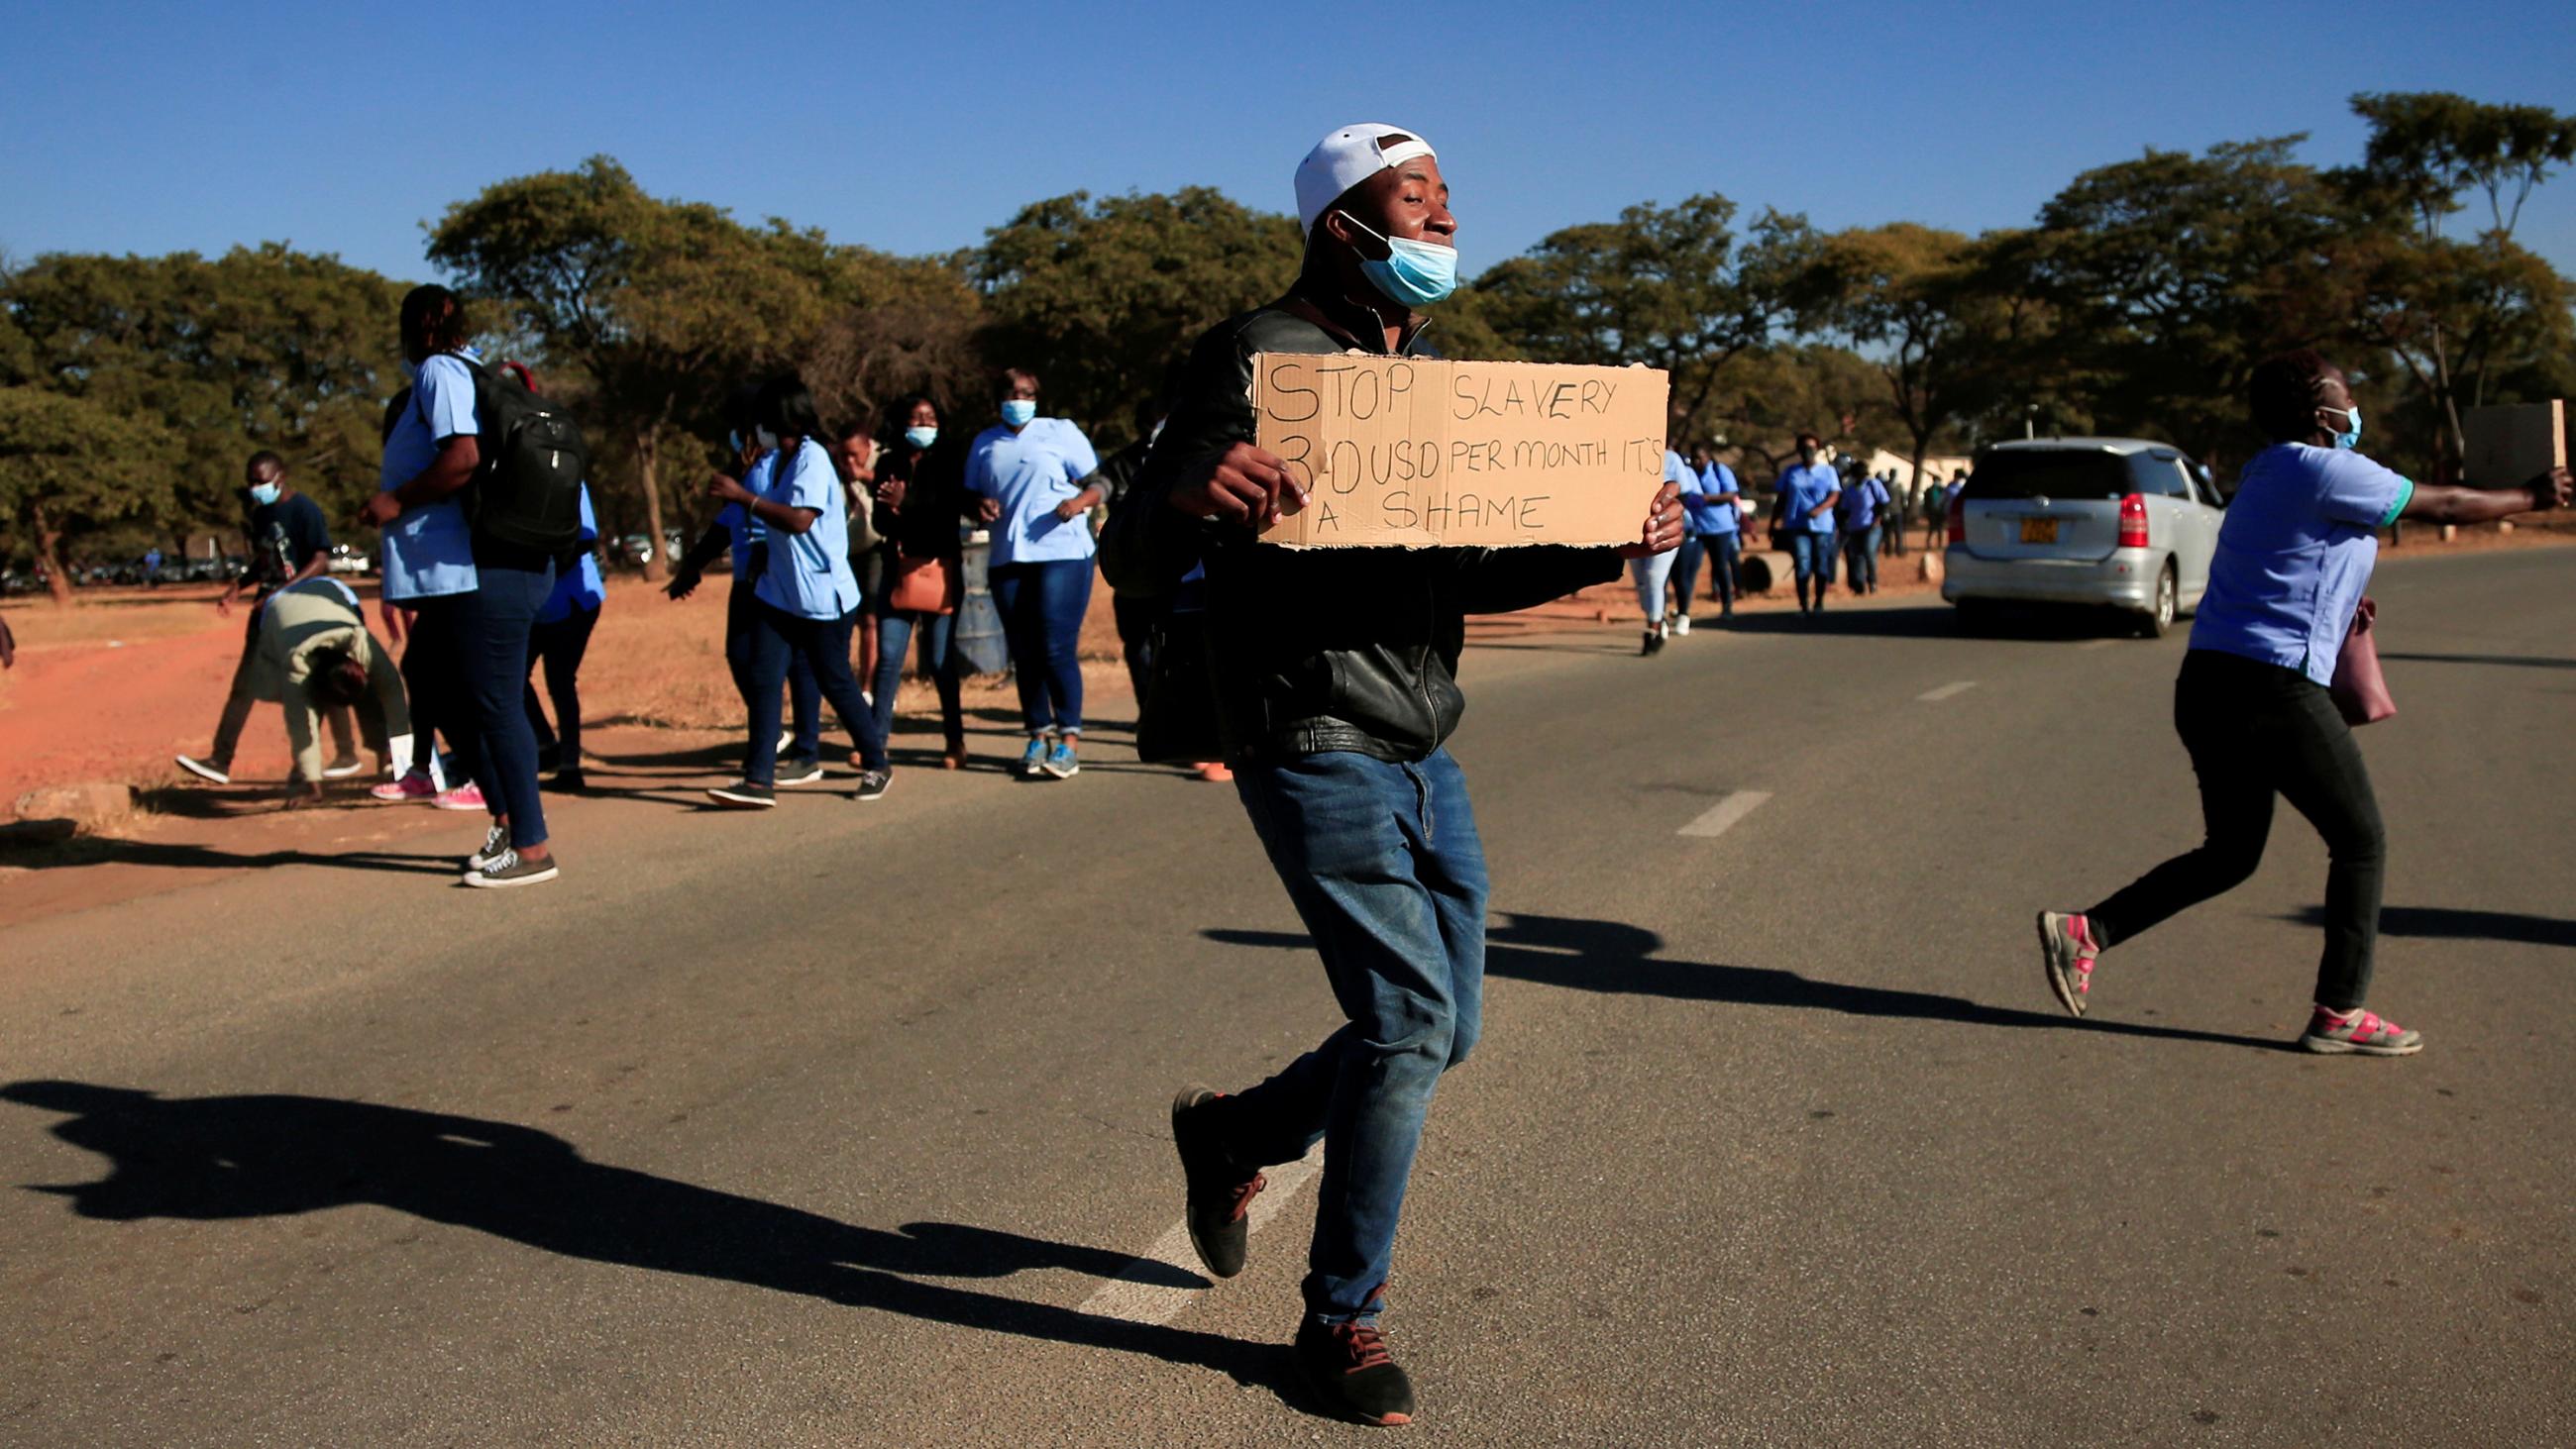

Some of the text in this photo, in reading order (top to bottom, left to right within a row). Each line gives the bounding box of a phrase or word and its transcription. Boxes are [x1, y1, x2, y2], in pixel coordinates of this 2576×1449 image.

[1267, 362, 1618, 422] STOP SLAVERY
[1450, 439, 1507, 473] PER
[1513, 439, 1607, 470] MONTH
[1622, 437, 1663, 475] IT'S
[1317, 490, 1551, 535] A SHAME
